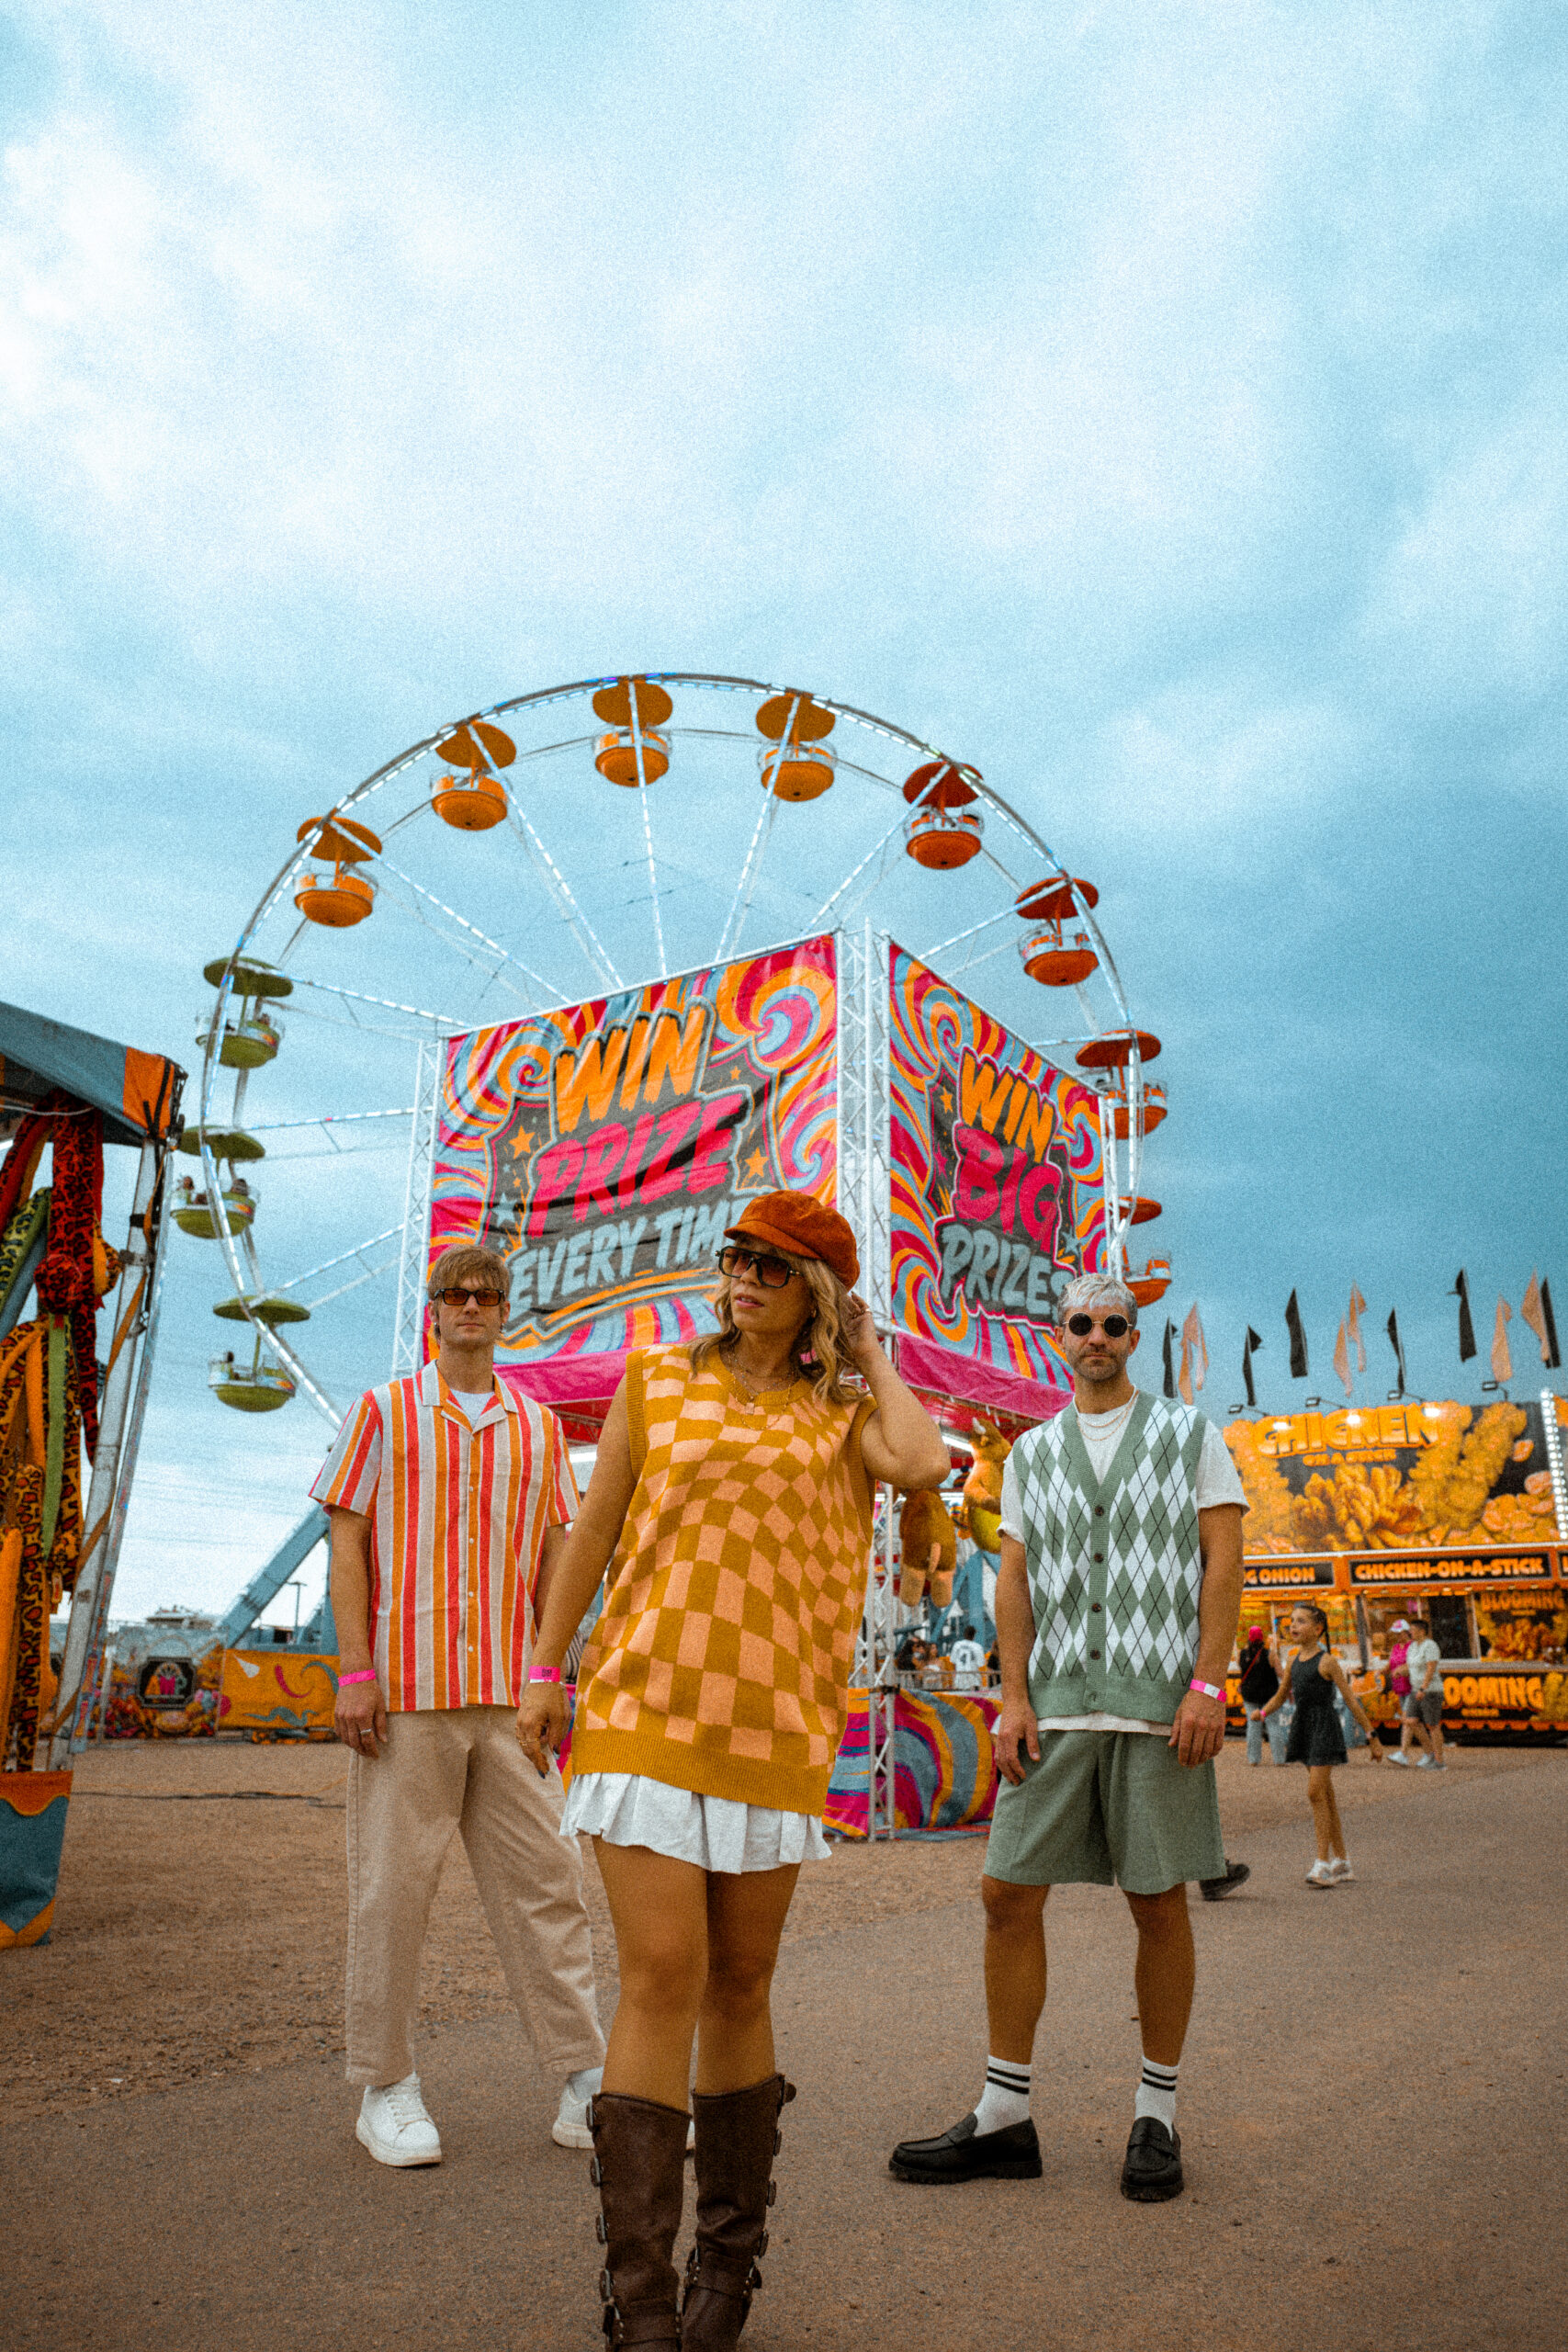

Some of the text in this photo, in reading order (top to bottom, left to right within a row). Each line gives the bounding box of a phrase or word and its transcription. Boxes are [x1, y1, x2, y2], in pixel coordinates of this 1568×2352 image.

[555, 1003, 704, 1134] WIN
[960, 1049, 1055, 1164] WIN
[527, 1092, 744, 1240] PRIZE
[957, 1126, 1062, 1253] BIG
[507, 1215, 652, 1322] EVERY
[1254, 1408, 1439, 1456] CHICKEN
[1258, 1566, 1315, 1585] ONION
[1355, 1557, 1544, 1580] CHICKEN-ON-A-STICK
[1443, 1676, 1544, 1710] OOMING
